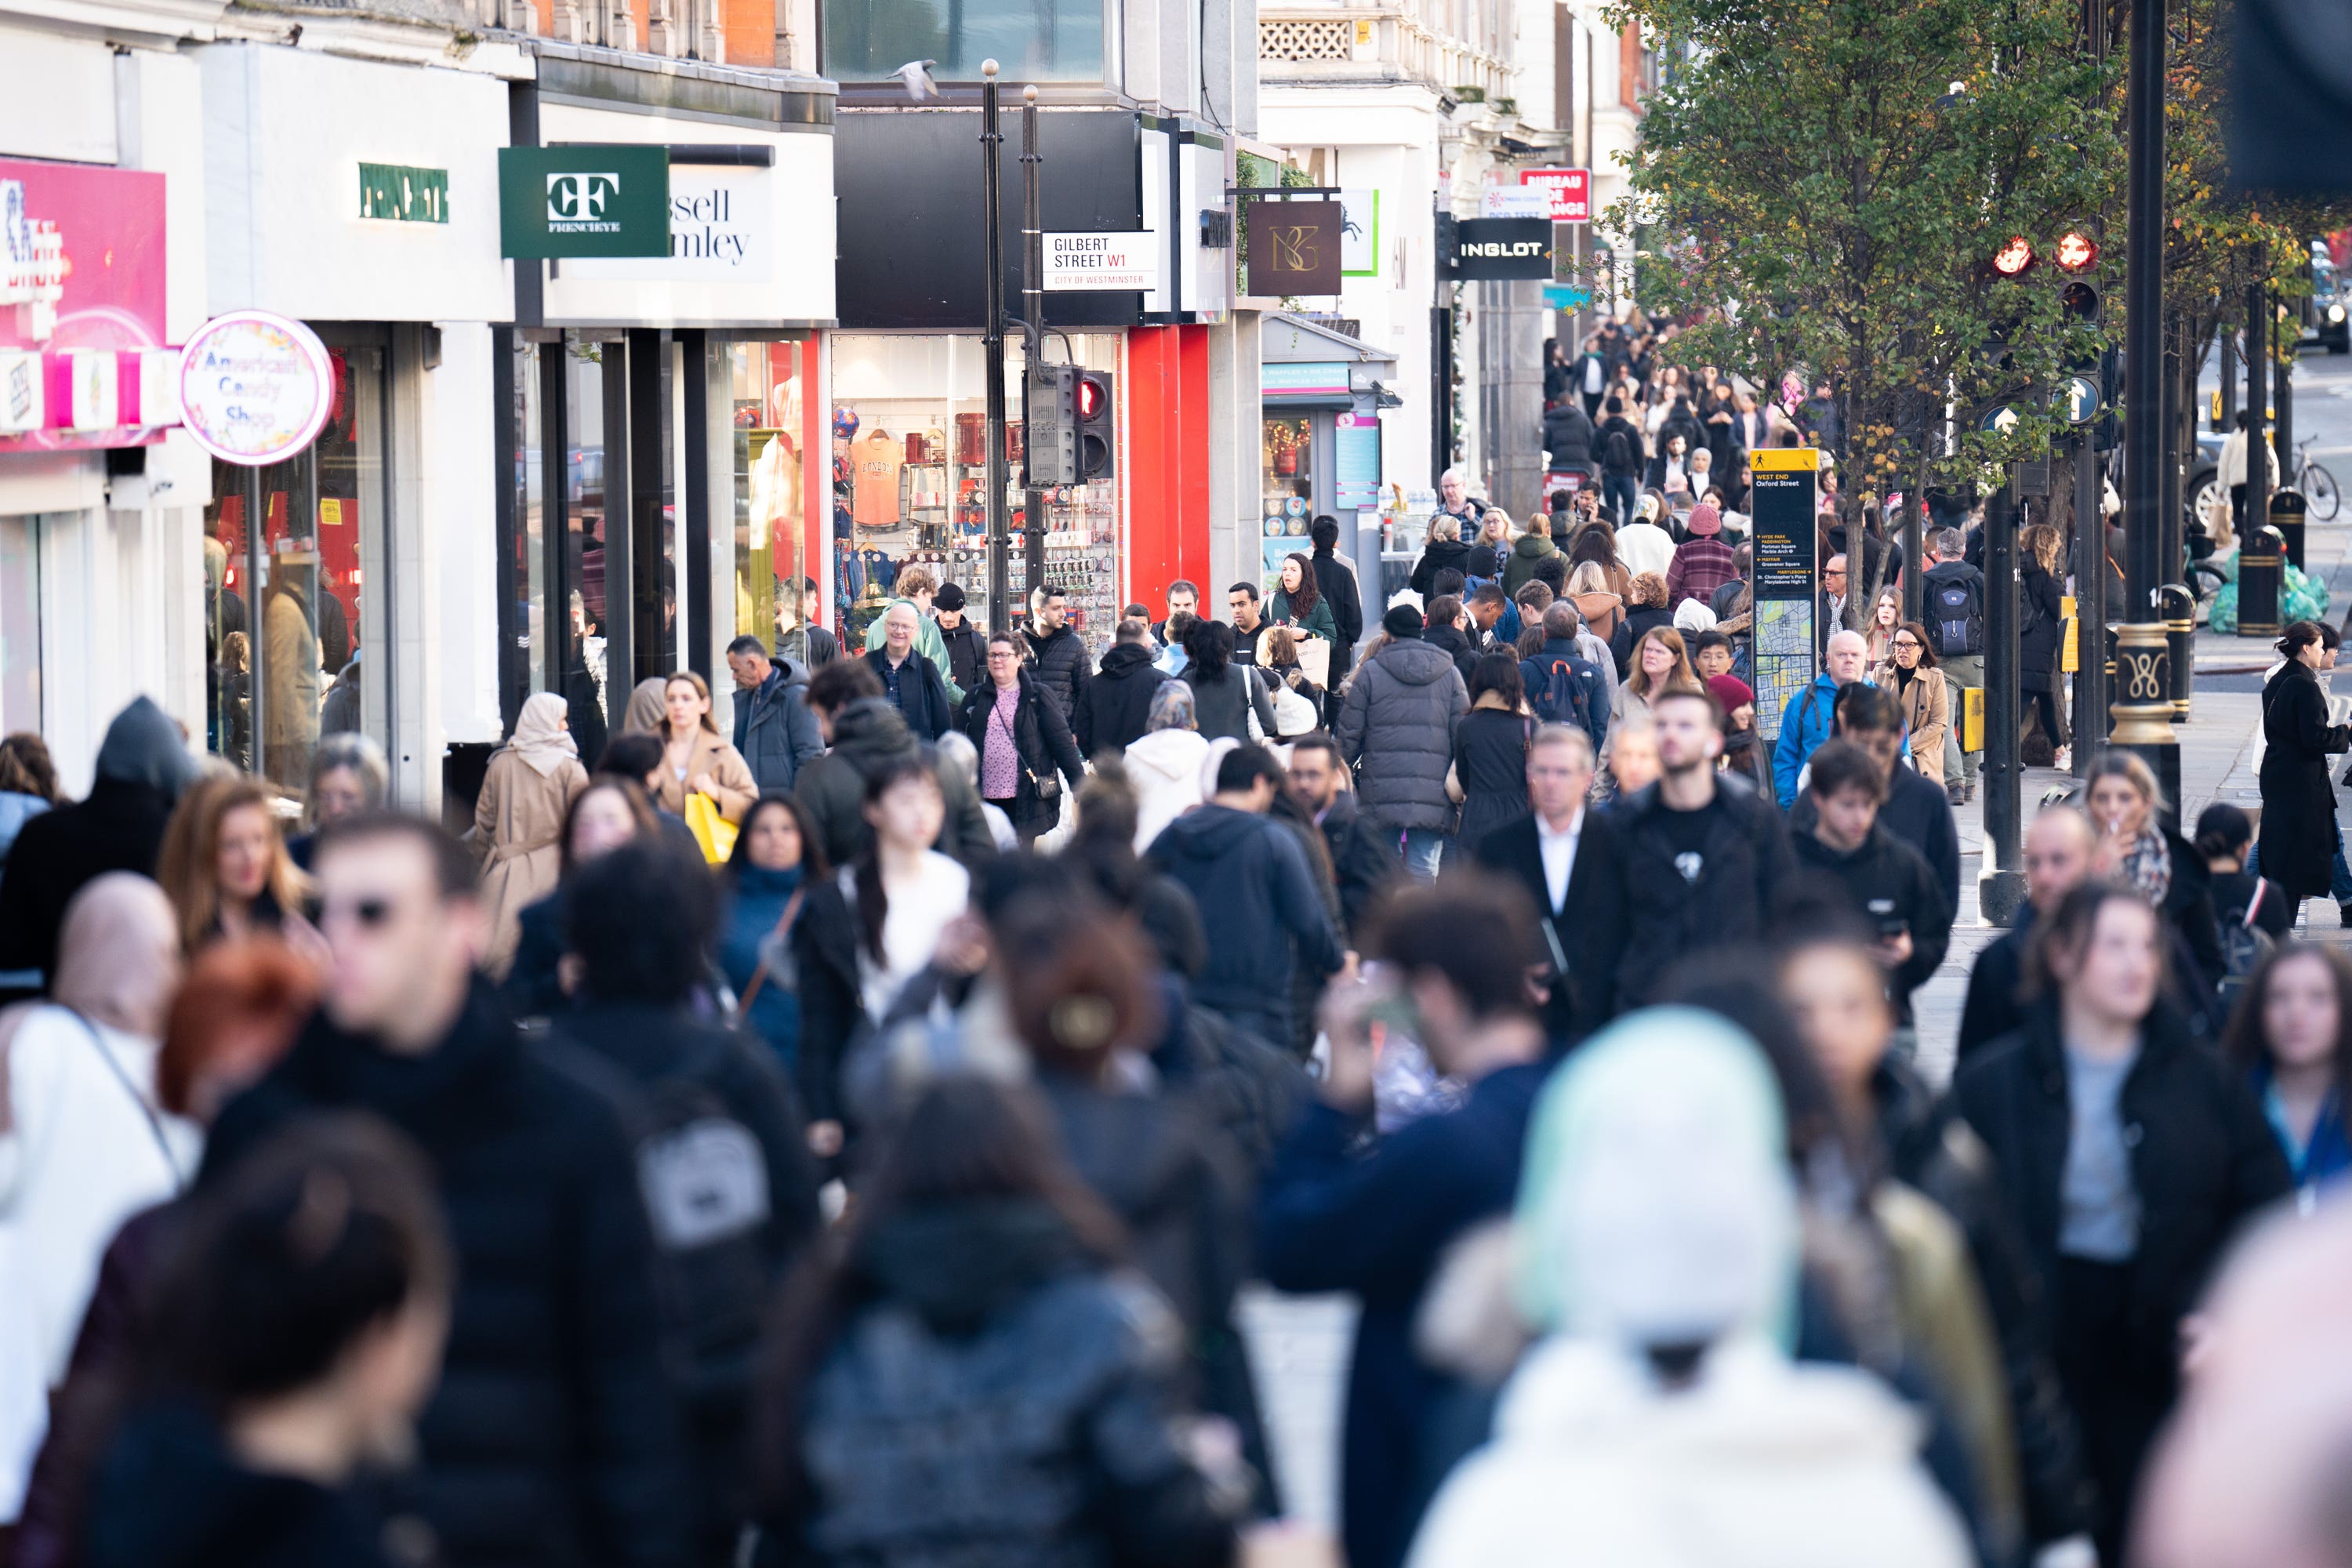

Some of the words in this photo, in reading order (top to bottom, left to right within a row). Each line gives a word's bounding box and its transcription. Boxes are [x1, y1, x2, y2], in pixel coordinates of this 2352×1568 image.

[1527, 176, 1581, 188] BUREAU
[669, 190, 729, 222] sell
[671, 226, 750, 267] mley
[1054, 238, 1109, 251] GILBERT
[1461, 242, 1543, 256] INGLOT
[1054, 255, 1103, 267] STREET
[1107, 254, 1126, 267] W1
[1087, 275, 1144, 284] WESTMINSTER
[219, 376, 282, 403] Candy
[226, 405, 277, 433] Shop
[862, 462, 892, 473] LONDON
